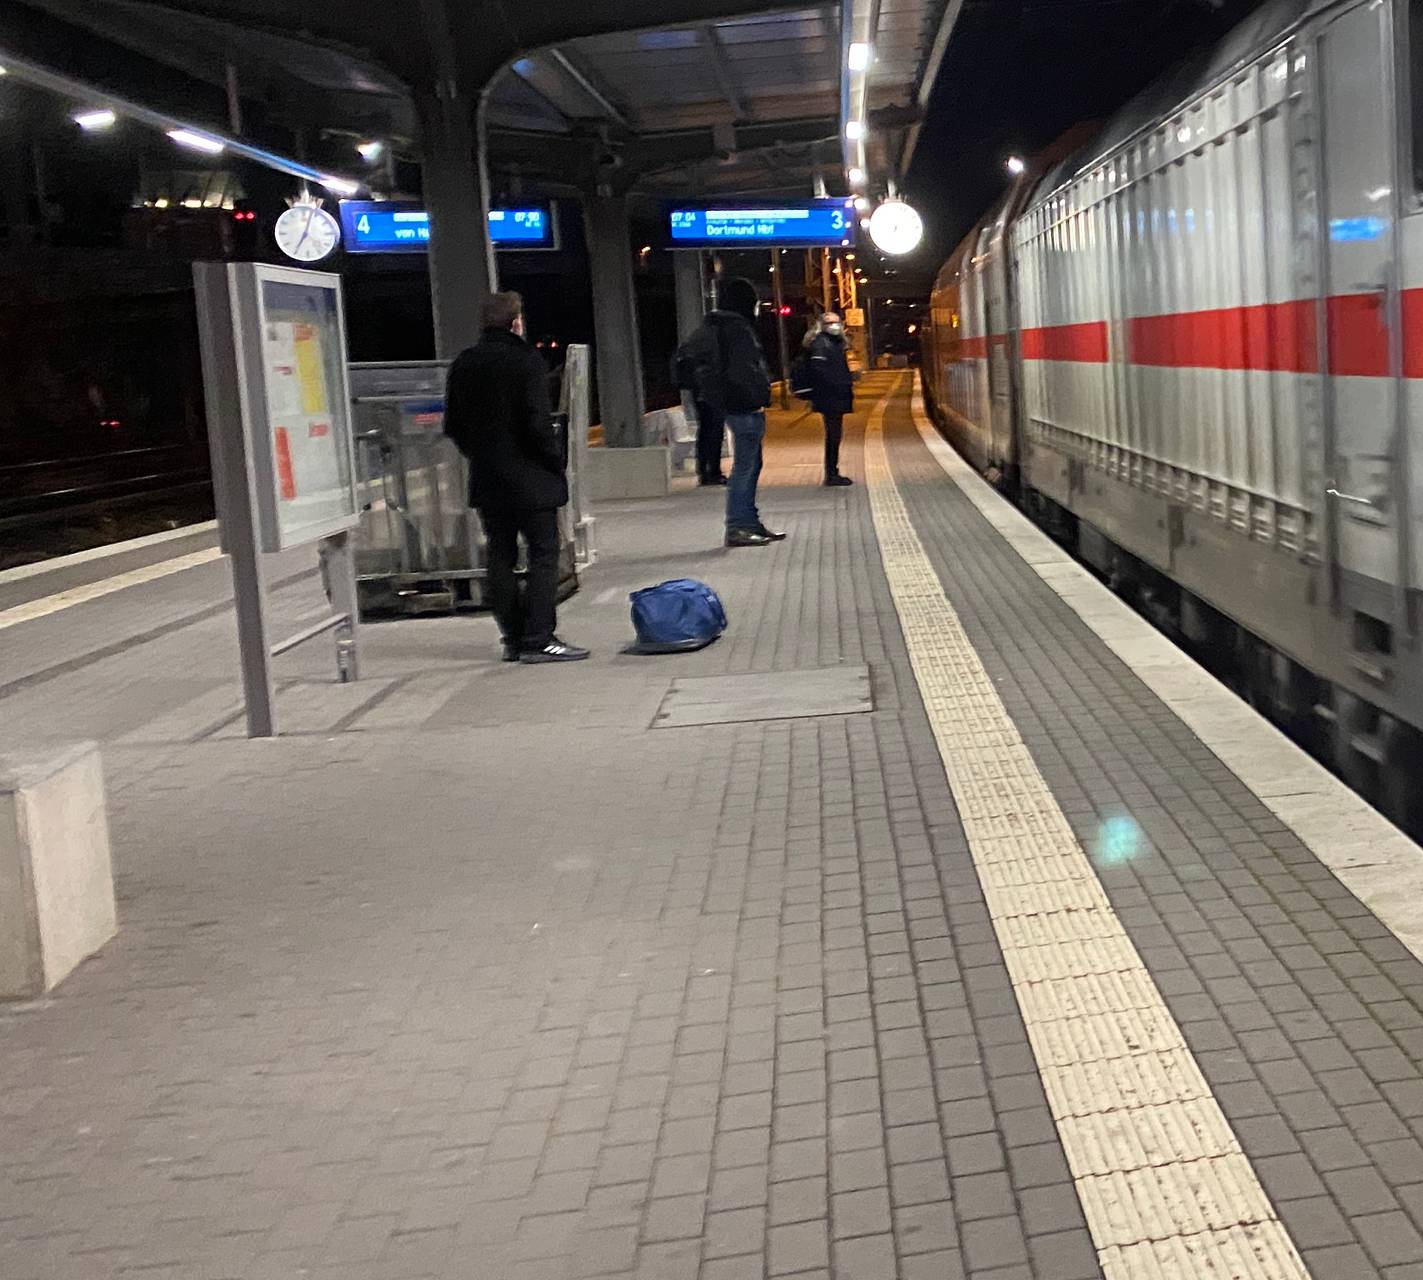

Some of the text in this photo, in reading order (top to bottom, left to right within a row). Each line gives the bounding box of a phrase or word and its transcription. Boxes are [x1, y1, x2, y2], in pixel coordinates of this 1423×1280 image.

[357, 214, 370, 234] 4
[831, 210, 843, 229] 3
[706, 224, 774, 236] Dortmund Hbf
